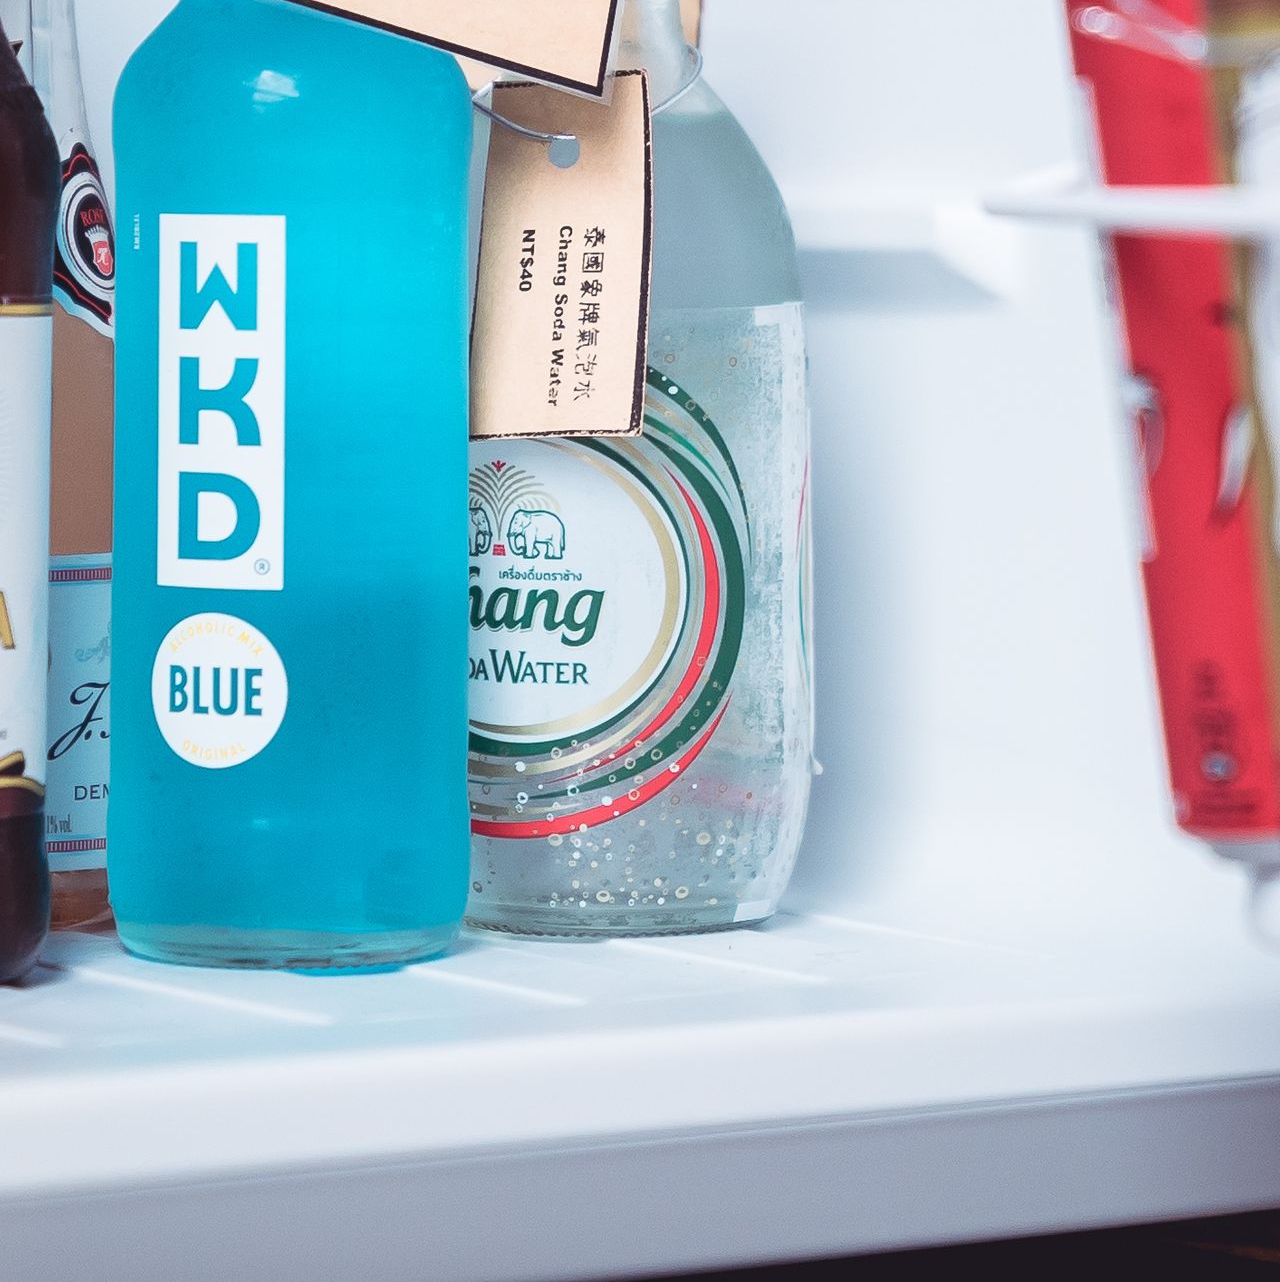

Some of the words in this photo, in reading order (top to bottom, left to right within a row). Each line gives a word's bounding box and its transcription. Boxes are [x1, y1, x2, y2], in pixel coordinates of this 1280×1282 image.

[519, 228, 536, 293] NT$40
[553, 225, 573, 288] Chang
[552, 293, 568, 342] Soda
[573, 226, 606, 402] 泰國象牌氣泡水
[178, 241, 262, 561] WKD
[548, 348, 564, 407] Water
[469, 566, 605, 647] hang
[169, 664, 263, 716] BLUE
